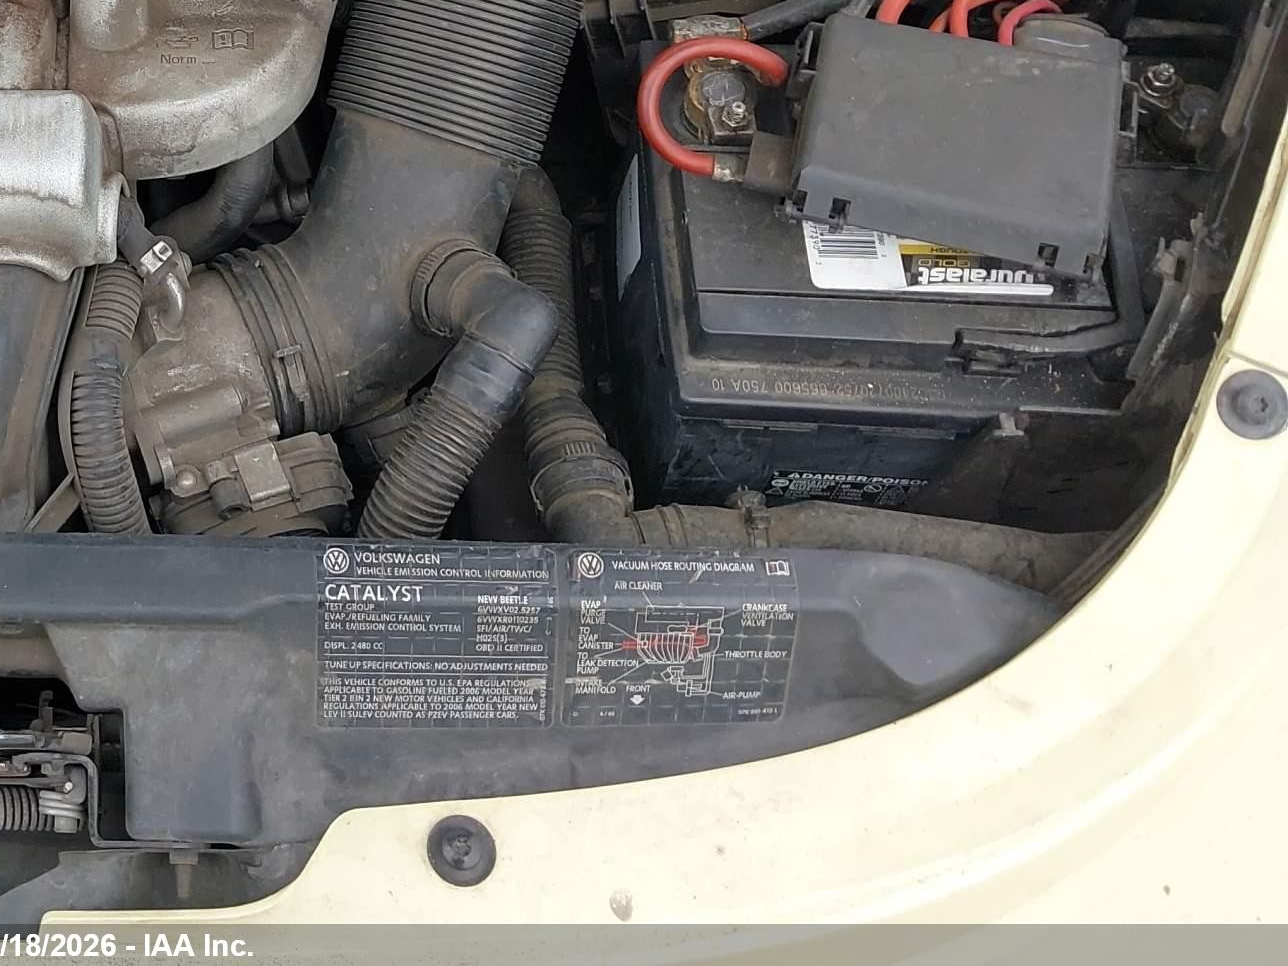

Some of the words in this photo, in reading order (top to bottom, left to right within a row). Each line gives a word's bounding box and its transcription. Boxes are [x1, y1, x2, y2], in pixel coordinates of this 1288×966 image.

[160, 54, 197, 65] Norm
[918, 258, 971, 267] GOLD
[711, 377, 725, 391] 10
[731, 378, 768, 394] 750A
[354, 552, 441, 565] VOLKSWAGEN
[612, 560, 650, 571] VACUUM
[651, 561, 673, 571] HOSE
[674, 561, 713, 572] ROUTING
[713, 562, 755, 572] DIAGRAM
[356, 566, 393, 575] VEHICLE
[394, 567, 438, 577] EMISSION
[440, 568, 482, 578] CONTROL
[484, 569, 550, 579] INFORMATION
[614, 581, 628, 590] AIR
[629, 581, 663, 591] CLEANER
[324, 584, 424, 603] CATALYST
[477, 594, 499, 604] NEW
[499, 595, 529, 605] BEETLE
[324, 603, 343, 611] TEST
[345, 603, 375, 611] GROUP
[580, 600, 601, 609] EVAP
[742, 603, 787, 612] CRANKCASE
[398, 613, 432, 622] FAMILY
[580, 616, 606, 624] VALVE
[741, 611, 794, 621] VENTILATION
[324, 621, 344, 630] EXH.
[345, 622, 385, 631] EMISSION
[387, 623, 426, 631] CONTROL
[428, 624, 462, 632] SYSTEM
[740, 619, 766, 627] VALVE
[578, 634, 599, 642] EVAP
[324, 641, 350, 650] DISPL.
[373, 642, 384, 650] CC
[475, 643, 495, 652] OBD
[504, 644, 544, 652] CERTIFIED
[578, 641, 614, 650] CANISTER
[577, 651, 588, 659] TO
[724, 650, 763, 659] THROTTLE
[763, 650, 787, 659] BODY
[324, 660, 347, 669] TUNE
[349, 661, 361, 669] UP
[362, 661, 433, 670] SPECIFICATIONS:
[434, 661, 449, 670] NO
[449, 662, 513, 671] ADJUSTMENTS
[514, 663, 548, 671] NEEDED
[577, 659, 596, 667] LEAK
[597, 659, 639, 667] DETECTION
[576, 666, 600, 675] PUMP
[324, 677, 342, 686] THIS
[344, 678, 377, 686] VEHICLE
[377, 678, 424, 686] CONFORMS
[426, 678, 438, 686] TO
[457, 679, 473, 687] EPA
[323, 686, 373, 694] APPLICABLE
[374, 686, 384, 694] TO
[386, 686, 426, 694] GASOLINE
[428, 687, 458, 695] FUELED
[460, 687, 480, 695] 2006
[482, 687, 511, 695] MODEL
[513, 688, 534, 696] YEAR
[575, 686, 617, 694] MANIFOLD
[625, 684, 651, 693] FRONT
[323, 694, 341, 702] TIER
[341, 694, 347, 702] 2
[365, 694, 371, 702] 2
[373, 694, 393, 703] NEW
[394, 695, 425, 703] MOTOR
[426, 695, 465, 703] VEHICLES
[466, 695, 485, 703] AND
[486, 695, 535, 703] CALIFORNIA
[722, 690, 761, 700] AIR-PUMP
[323, 702, 379, 710] REGULATIONS
[381, 702, 429, 711] APPLICABLE
[430, 703, 442, 711] TO
[443, 703, 463, 711] 2006
[464, 703, 494, 711] MODEL
[496, 703, 518, 711] YEAR
[518, 703, 539, 711] NEW
[323, 710, 339, 718] LEV
[347, 710, 373, 718] SULEV
[374, 710, 414, 719] COUNTED
[415, 711, 426, 719] AS
[449, 711, 495, 720] PASSENGER
